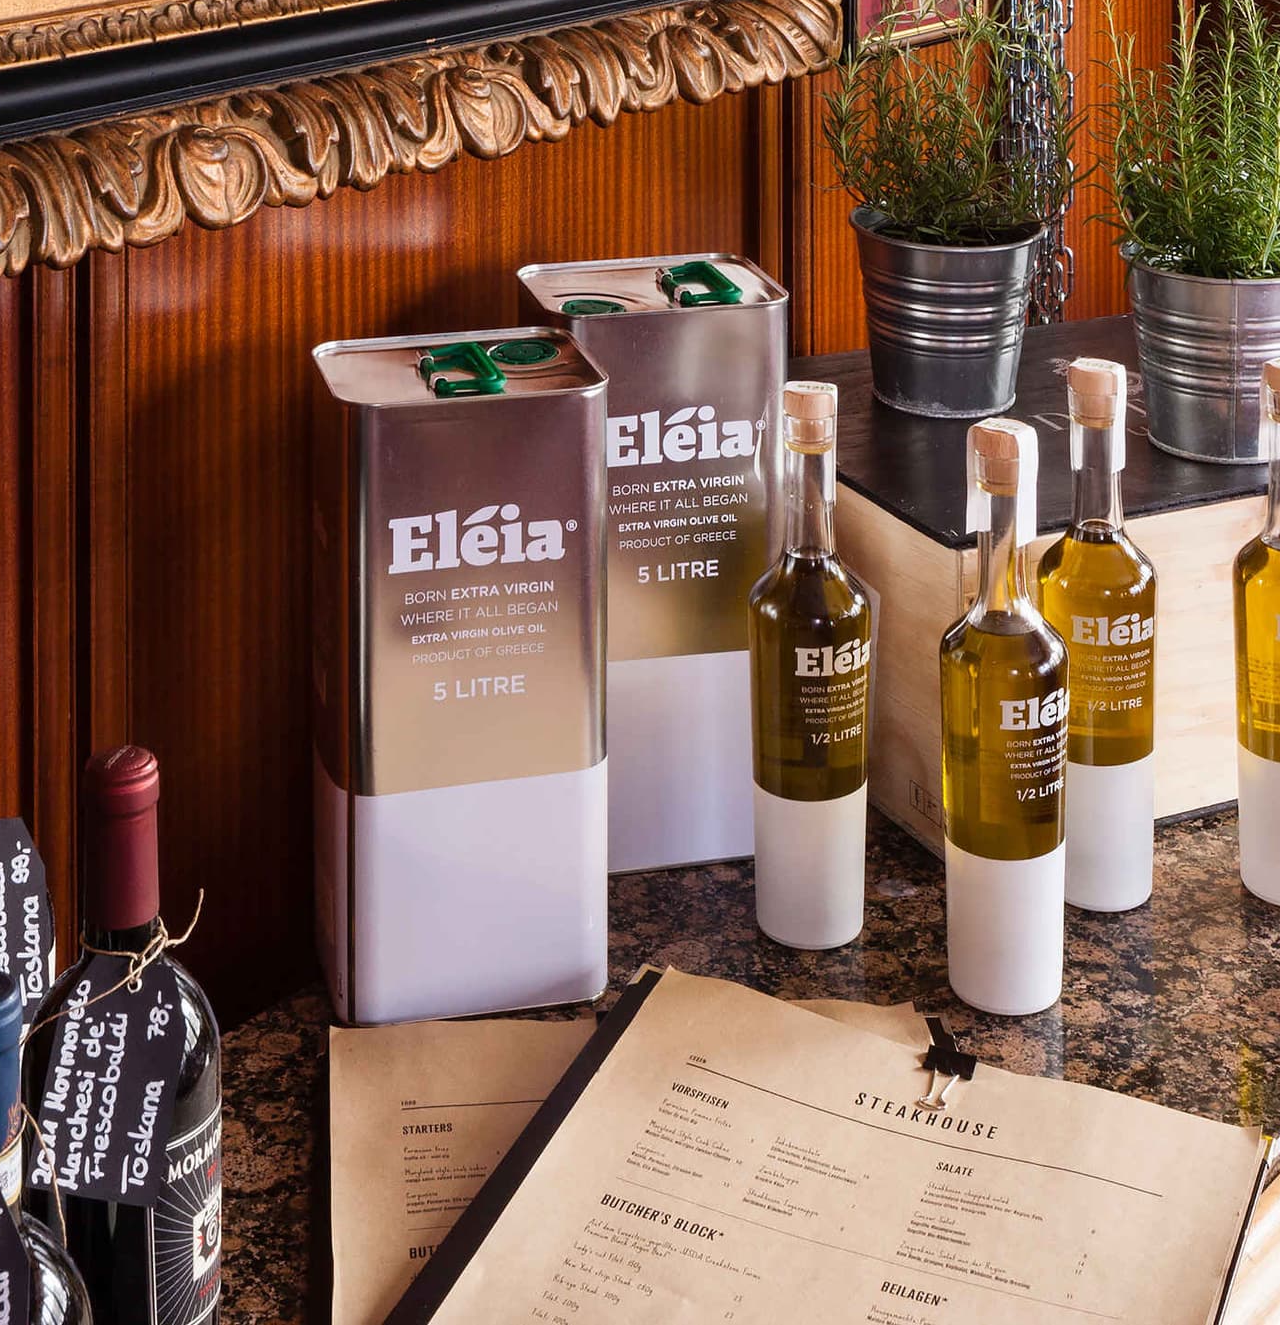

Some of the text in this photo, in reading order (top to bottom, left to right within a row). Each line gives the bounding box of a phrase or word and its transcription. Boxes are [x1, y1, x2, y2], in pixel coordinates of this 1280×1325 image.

[607, 405, 755, 468] Eléia
[612, 475, 745, 496] BORN EXTRA VIRGIN
[609, 493, 748, 515] WHERE IT ALL BEGAN
[619, 513, 738, 532] EXTRA VIRGIN OLIVE OIL
[388, 504, 566, 574] Eléia
[620, 530, 737, 549] PRODUCT OF GREECE
[638, 560, 719, 584] 5 LITRE
[405, 580, 554, 605] BORN EXTRA VIRGIN
[401, 601, 558, 626] WHERE IT ALL BEGAN
[411, 624, 546, 645] EXTRA VIRGIN OLIVE OIL
[1071, 613, 1154, 646] Eléia
[413, 643, 544, 664] PRODUCT OF GREECE
[434, 674, 526, 701] 5 LITRE
[1111, 697, 1143, 711] LITRE
[834, 724, 862, 741] LITRE
[1039, 778, 1064, 797] LITRE
[16, 896, 40, 1006] Toskana
[672, 1082, 729, 1109] VORSPEISEN
[855, 1092, 998, 1139] STEAKHOUSE
[56, 1070, 96, 1191] Marchesi
[120, 1079, 165, 1194] Toskana
[403, 1123, 453, 1135] STARTERS
[936, 1162, 973, 1177] SALATE
[601, 1194, 671, 1225] BUTCHER'S
